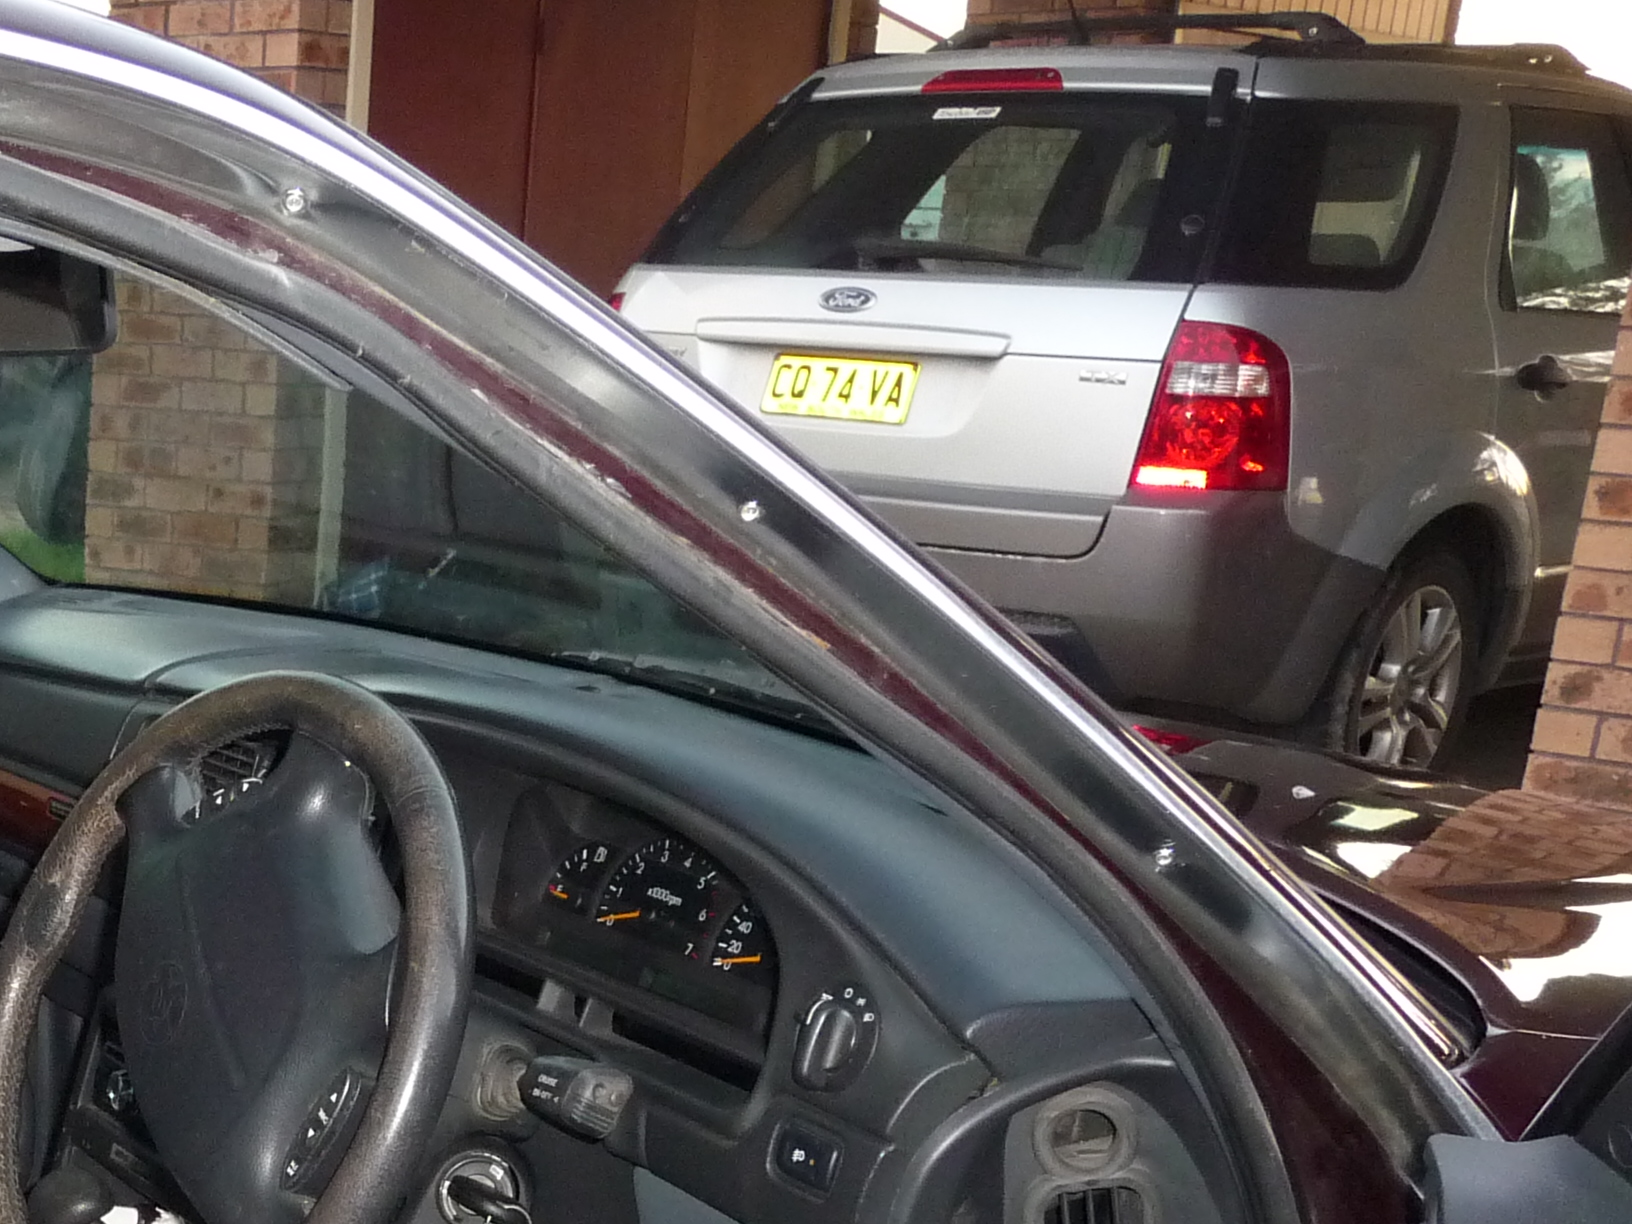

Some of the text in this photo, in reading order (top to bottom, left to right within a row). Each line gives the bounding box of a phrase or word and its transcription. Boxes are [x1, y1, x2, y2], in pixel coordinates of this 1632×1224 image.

[772, 364, 904, 408] CQ 74 VA
[660, 851, 669, 863] 3
[683, 857, 693, 868] 4
[635, 862, 645, 875] 2
[696, 877, 706, 890] 5
[698, 908, 707, 921] 6
[737, 921, 753, 934] 40
[684, 943, 695, 955] 7
[727, 939, 743, 954] 20
